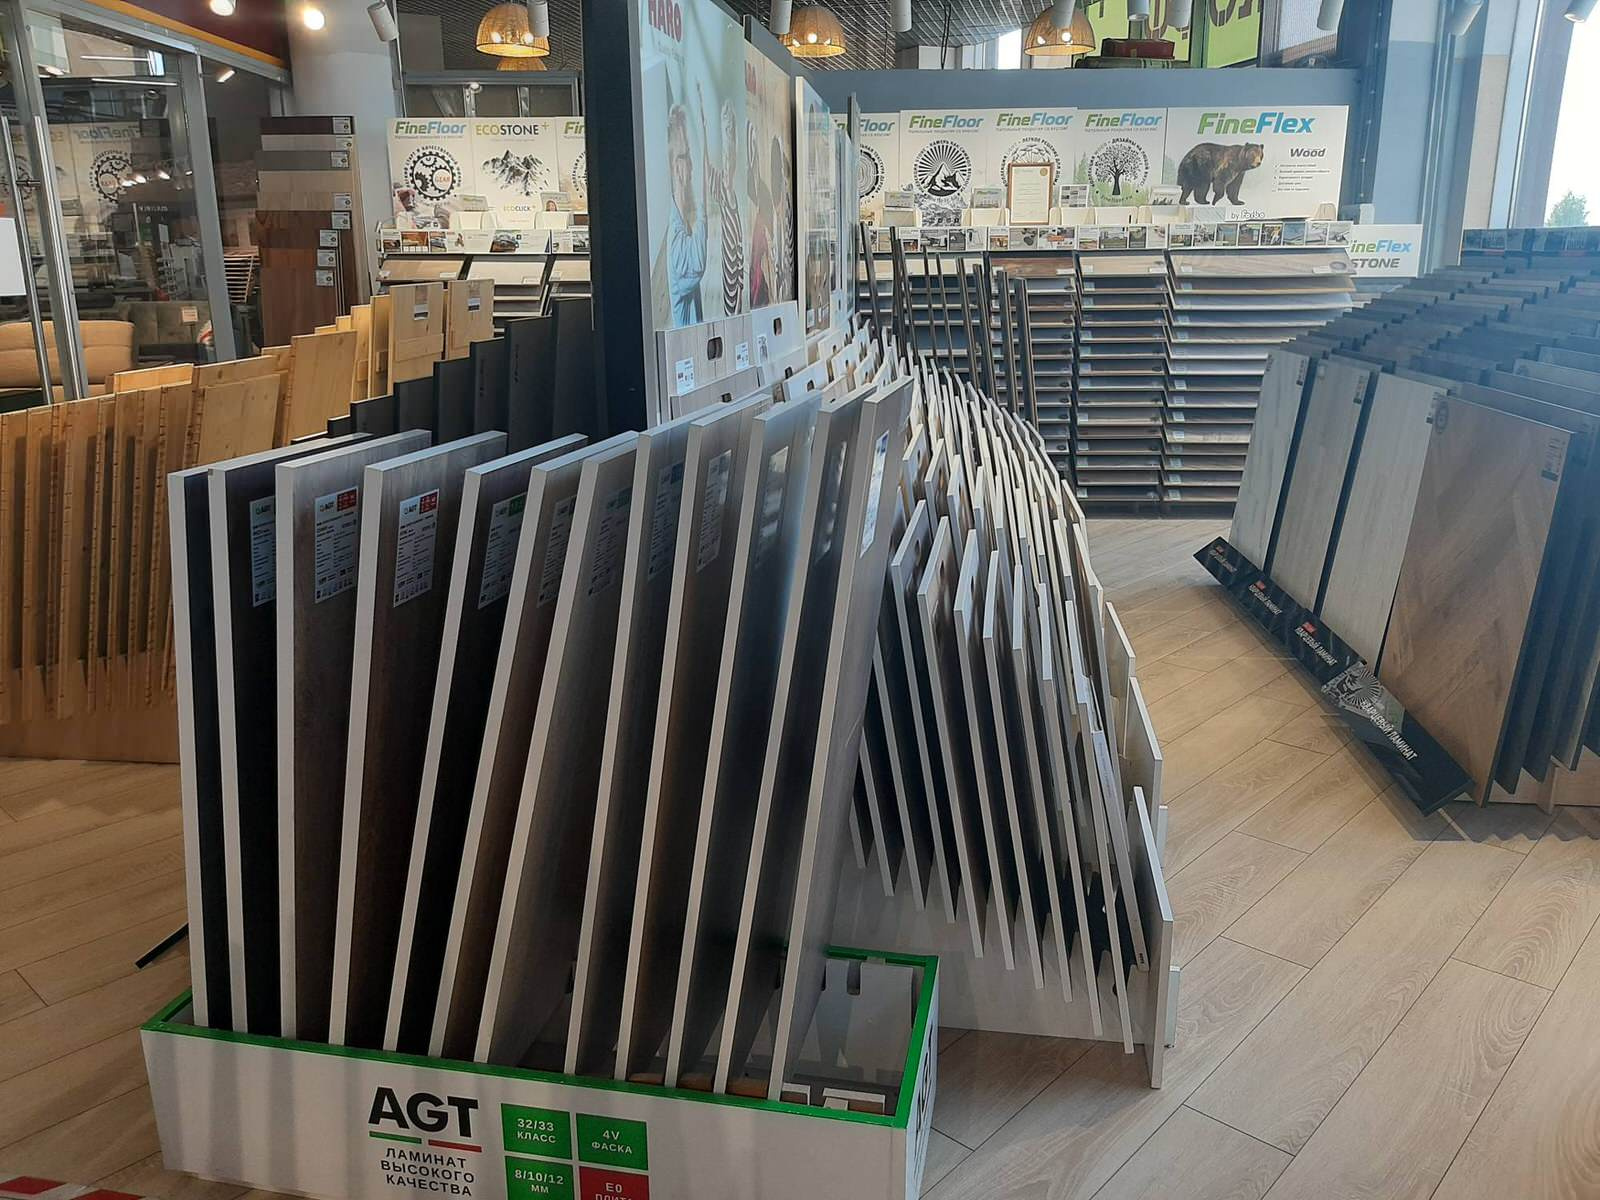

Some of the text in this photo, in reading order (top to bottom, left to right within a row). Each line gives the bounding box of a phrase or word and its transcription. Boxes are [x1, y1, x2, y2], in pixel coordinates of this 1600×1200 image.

[648, 0, 682, 42] HARO
[909, 115, 984, 128] FineFloor
[996, 112, 1073, 126] FineFloor
[1085, 112, 1162, 127] FineFloor
[1197, 112, 1315, 134] FineFlex
[395, 121, 466, 134] FineFloor
[1290, 148, 1326, 158] Wood
[1351, 240, 1412, 253] ineFlex
[1350, 258, 1401, 269] STONE
[1386, 730, 1418, 761] ЛАМИНАТ
[368, 1087, 479, 1138] AGT
[517, 1118, 554, 1132] 32/33
[517, 1131, 556, 1144] КЛАСС
[602, 1130, 620, 1141] 4V
[591, 1141, 633, 1155] ФАСКА
[386, 1148, 467, 1169] ЛАМИНАТ
[380, 1160, 475, 1184] ВЫСОКОГО
[514, 1169, 564, 1186] 8/10/12
[386, 1174, 472, 1197] КАЧЕСТВА
